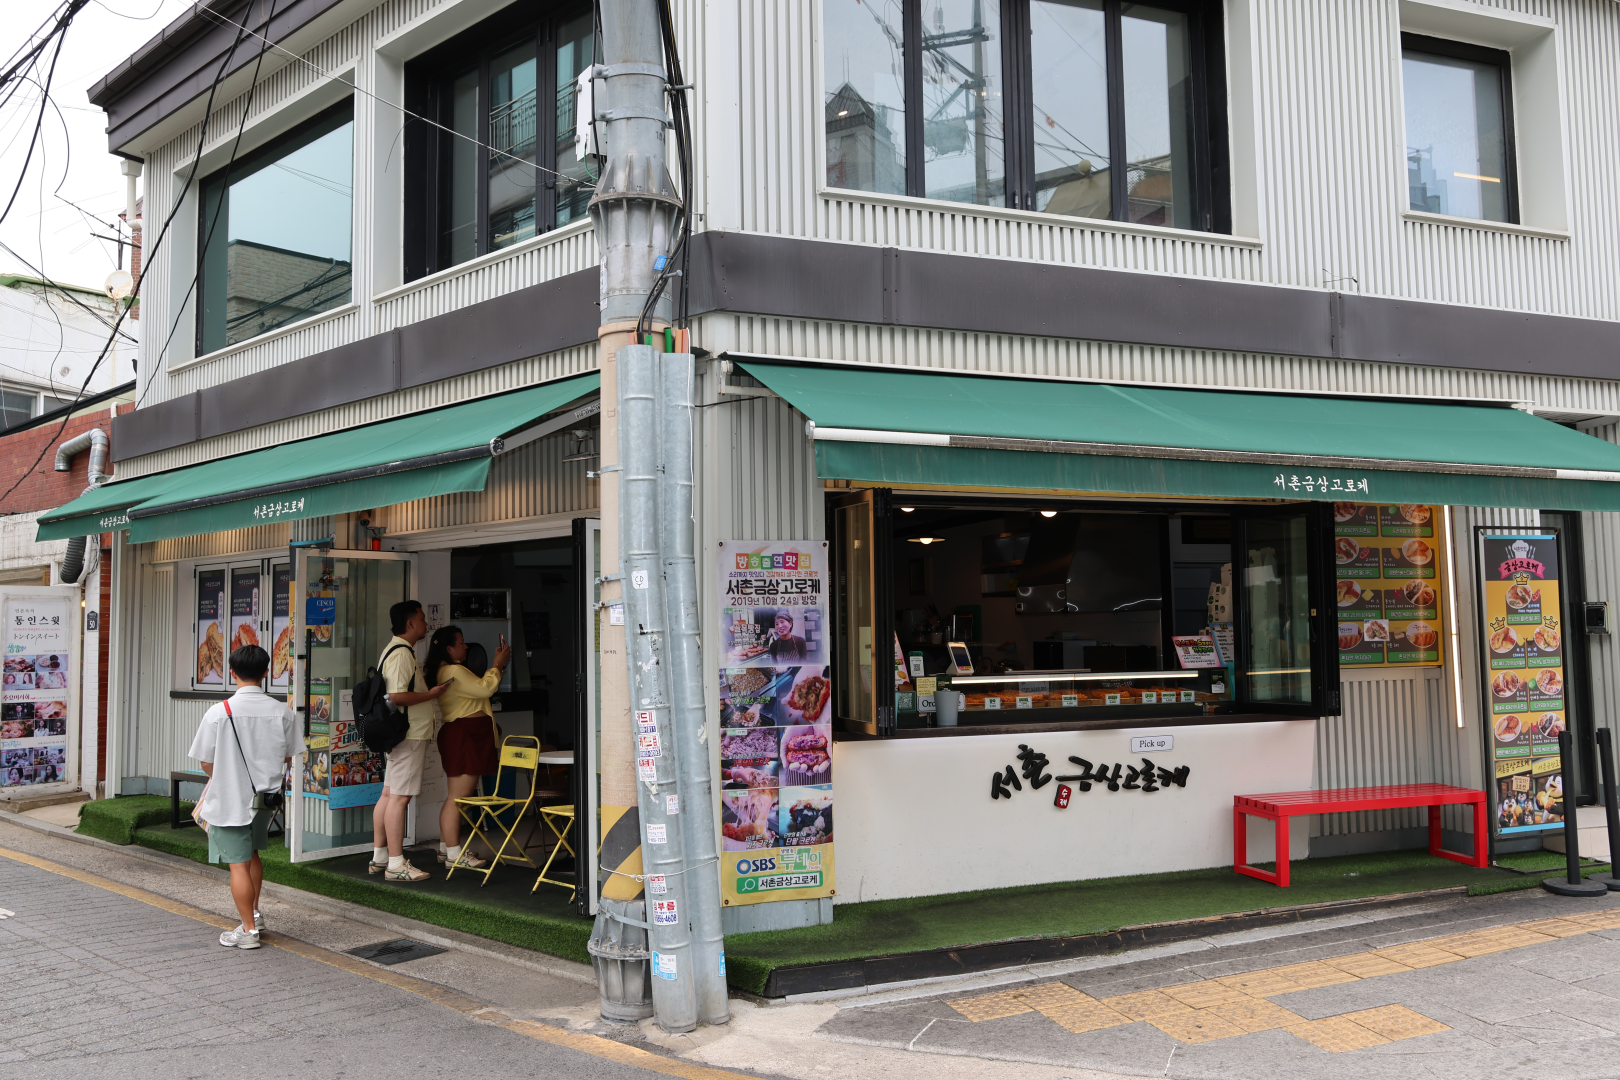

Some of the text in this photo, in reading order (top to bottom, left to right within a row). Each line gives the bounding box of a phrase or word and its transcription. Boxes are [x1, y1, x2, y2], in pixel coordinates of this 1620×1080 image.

[1273, 473, 1369, 494] 서촌금상고로케
[253, 497, 305, 519] 서촌금상고로케
[1504, 560, 1539, 573] 금상고로케
[726, 578, 821, 596] 서촌금상고로케
[316, 599, 334, 607] CESCO
[730, 595, 817, 606] 2019년 10월 24일 방영
[14, 615, 60, 626] 통인스윗
[89, 620, 96, 629] 50
[1139, 740, 1166, 748] Pick up
[991, 744, 1191, 800] 서촌 금상고로케
[751, 857, 776, 873] SBS
[778, 850, 822, 871] 투데이
[760, 874, 818, 888] 서촌금상고로케
